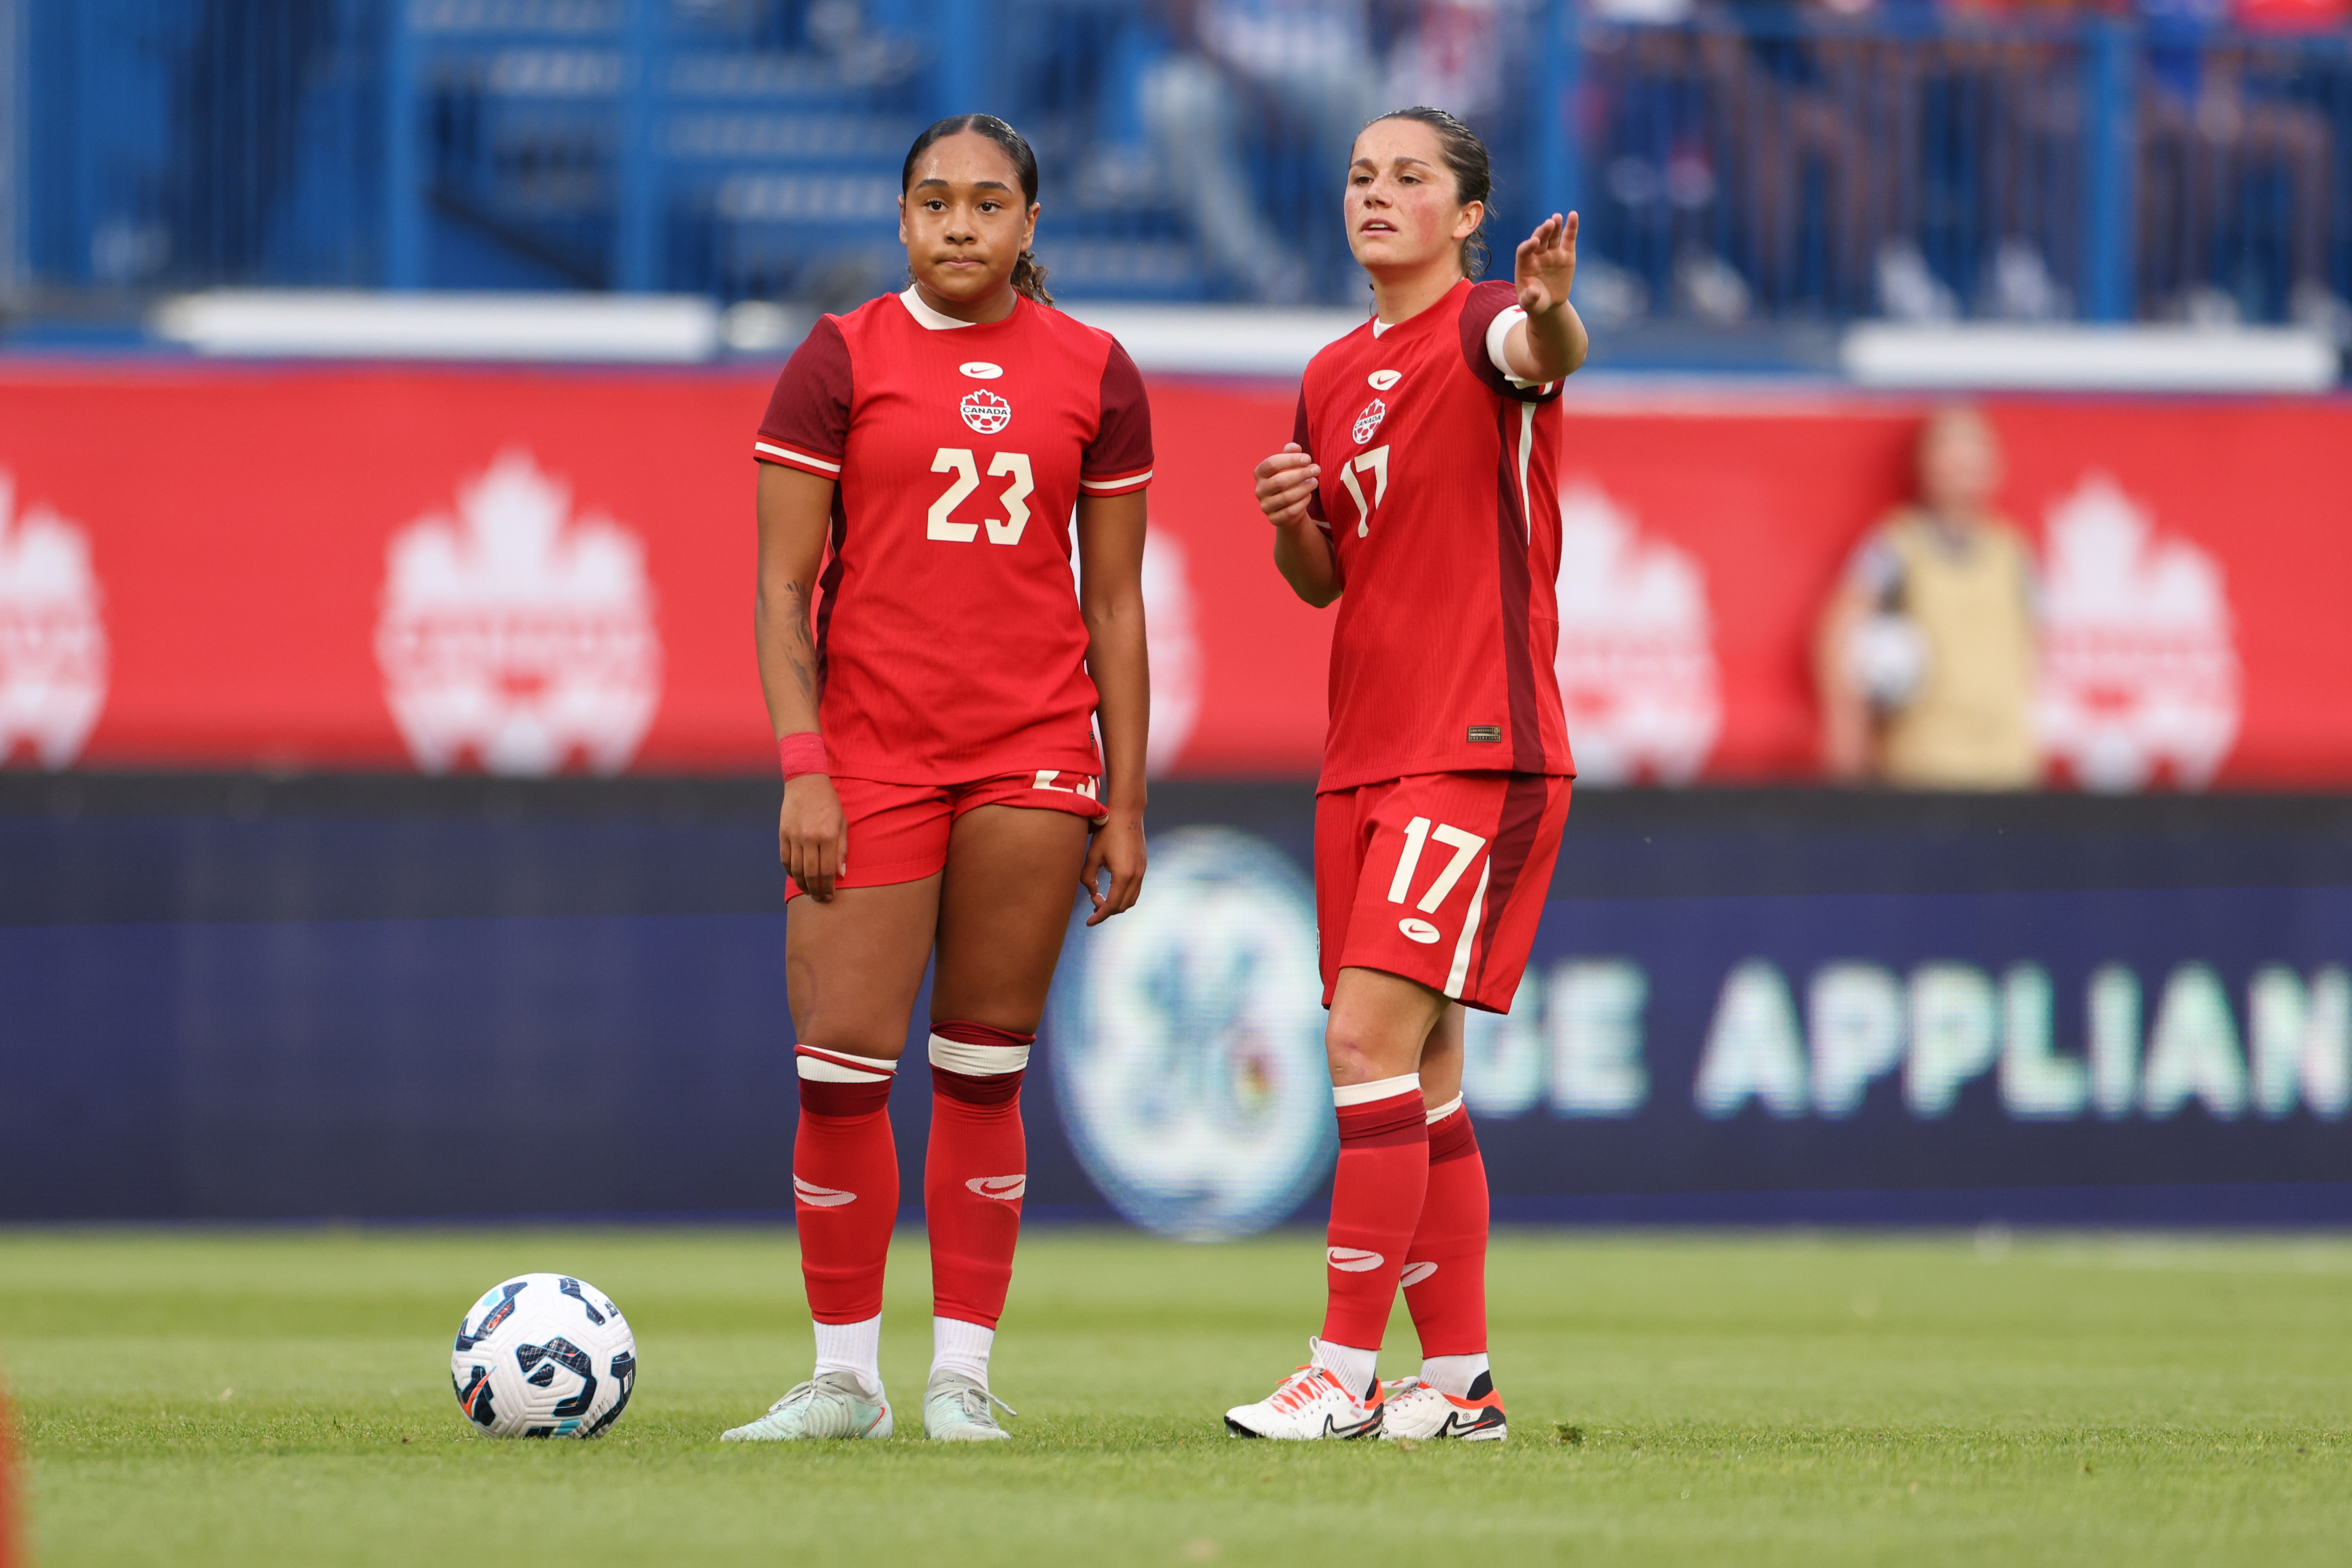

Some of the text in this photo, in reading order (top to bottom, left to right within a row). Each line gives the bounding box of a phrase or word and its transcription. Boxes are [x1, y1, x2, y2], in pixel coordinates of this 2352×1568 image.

[963, 406, 1008, 415] CANADA
[1355, 414, 1381, 428] CANADA
[926, 447, 1035, 545] 23
[1339, 444, 1390, 539] 17
[1387, 816, 1487, 915] 17
[1696, 960, 2352, 1118] APPLIAN
